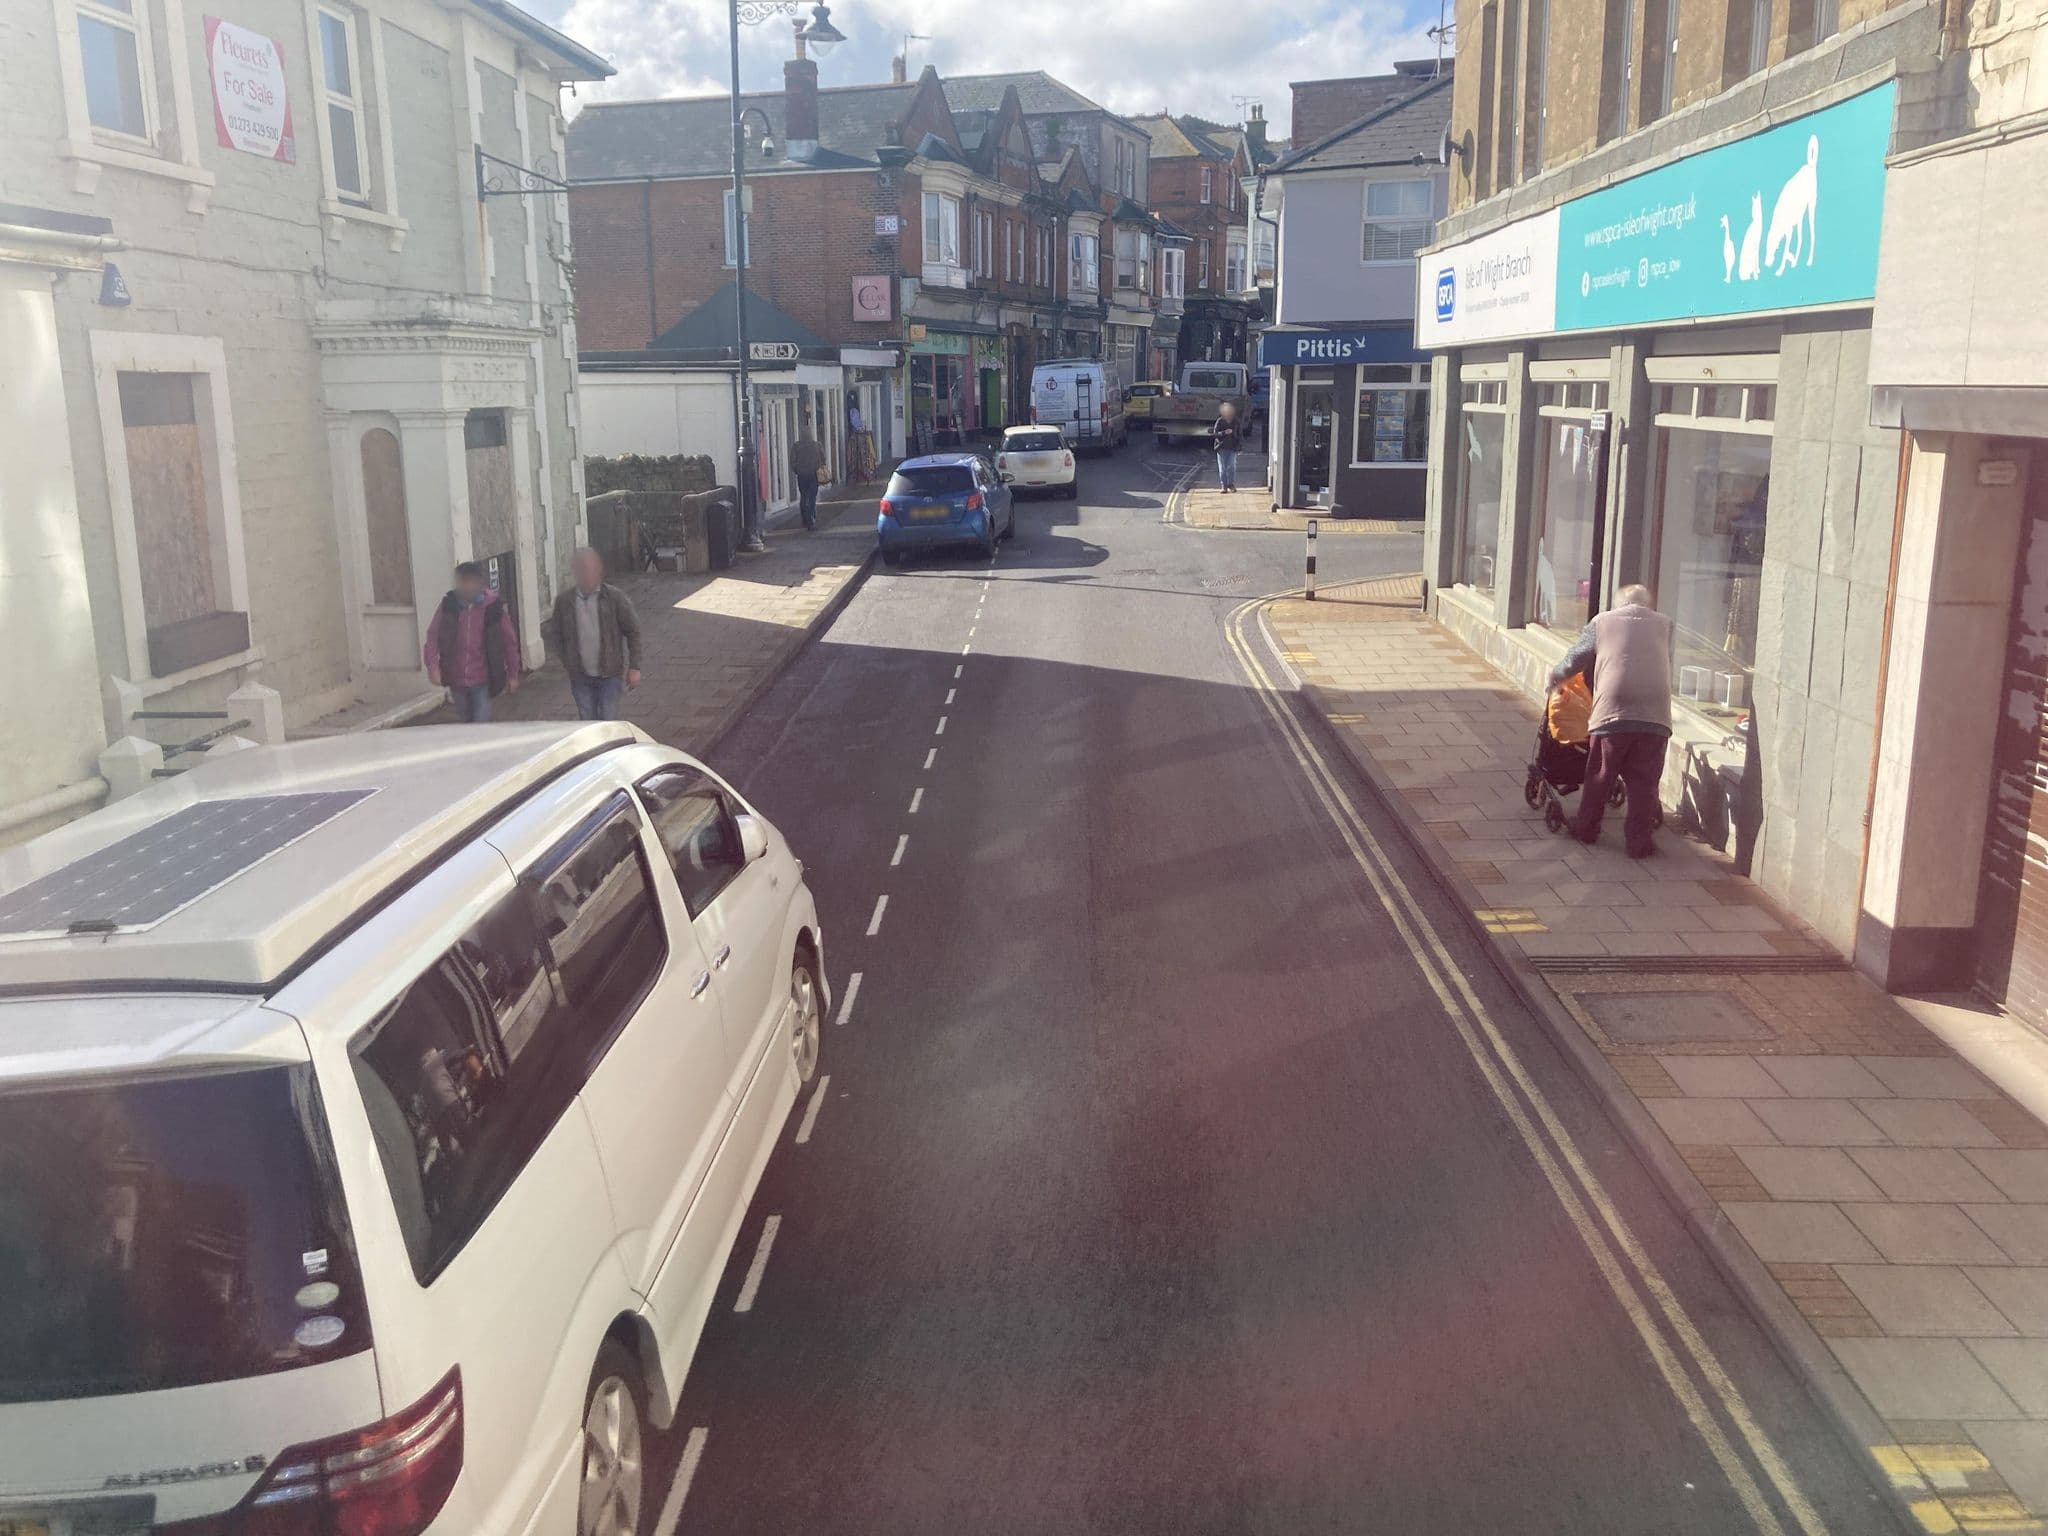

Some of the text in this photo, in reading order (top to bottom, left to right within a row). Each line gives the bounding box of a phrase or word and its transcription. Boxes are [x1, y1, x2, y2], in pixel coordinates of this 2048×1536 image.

[224, 71, 274, 105] For Sale
[1465, 247, 1532, 291] Isle of Wight Branch
[1297, 338, 1352, 358] Pittis
